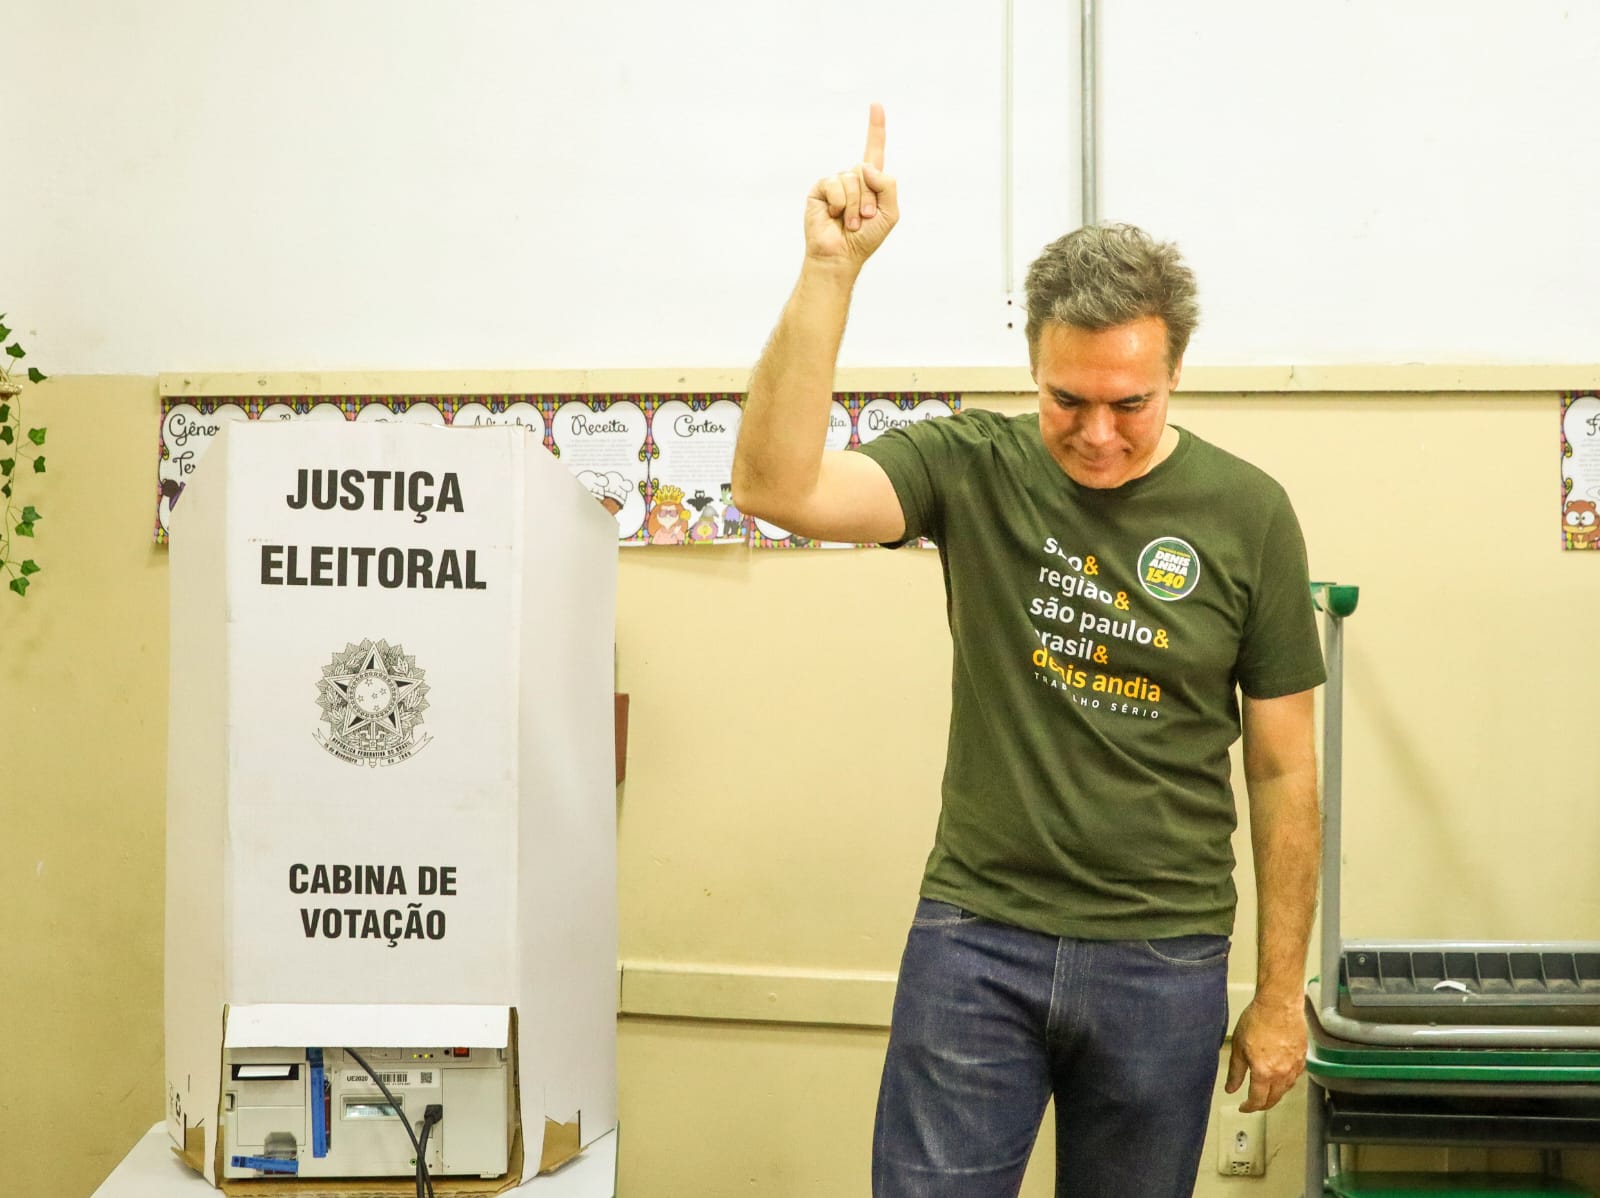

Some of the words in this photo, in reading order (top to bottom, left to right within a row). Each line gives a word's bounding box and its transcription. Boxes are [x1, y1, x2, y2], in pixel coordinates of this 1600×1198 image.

[571, 413, 630, 436] Receita
[673, 413, 727, 438] Contos
[286, 469, 465, 524] JUSTIÇA
[261, 545, 487, 590] ELEITORAL
[1148, 558, 1188, 577] ANDIA
[1154, 550, 1191, 567] DENIS
[1038, 565, 1131, 611] região&
[1145, 567, 1186, 589] 1540
[1029, 595, 1076, 624] são
[1079, 611, 1170, 649] paulo&
[1092, 672, 1163, 703] andia
[1110, 702, 1161, 719] SÉRIO
[289, 863, 407, 896] CABINA
[418, 865, 457, 896] DE
[300, 904, 446, 948] VOTAÇÃO
[346, 1074, 369, 1083] UE2020
